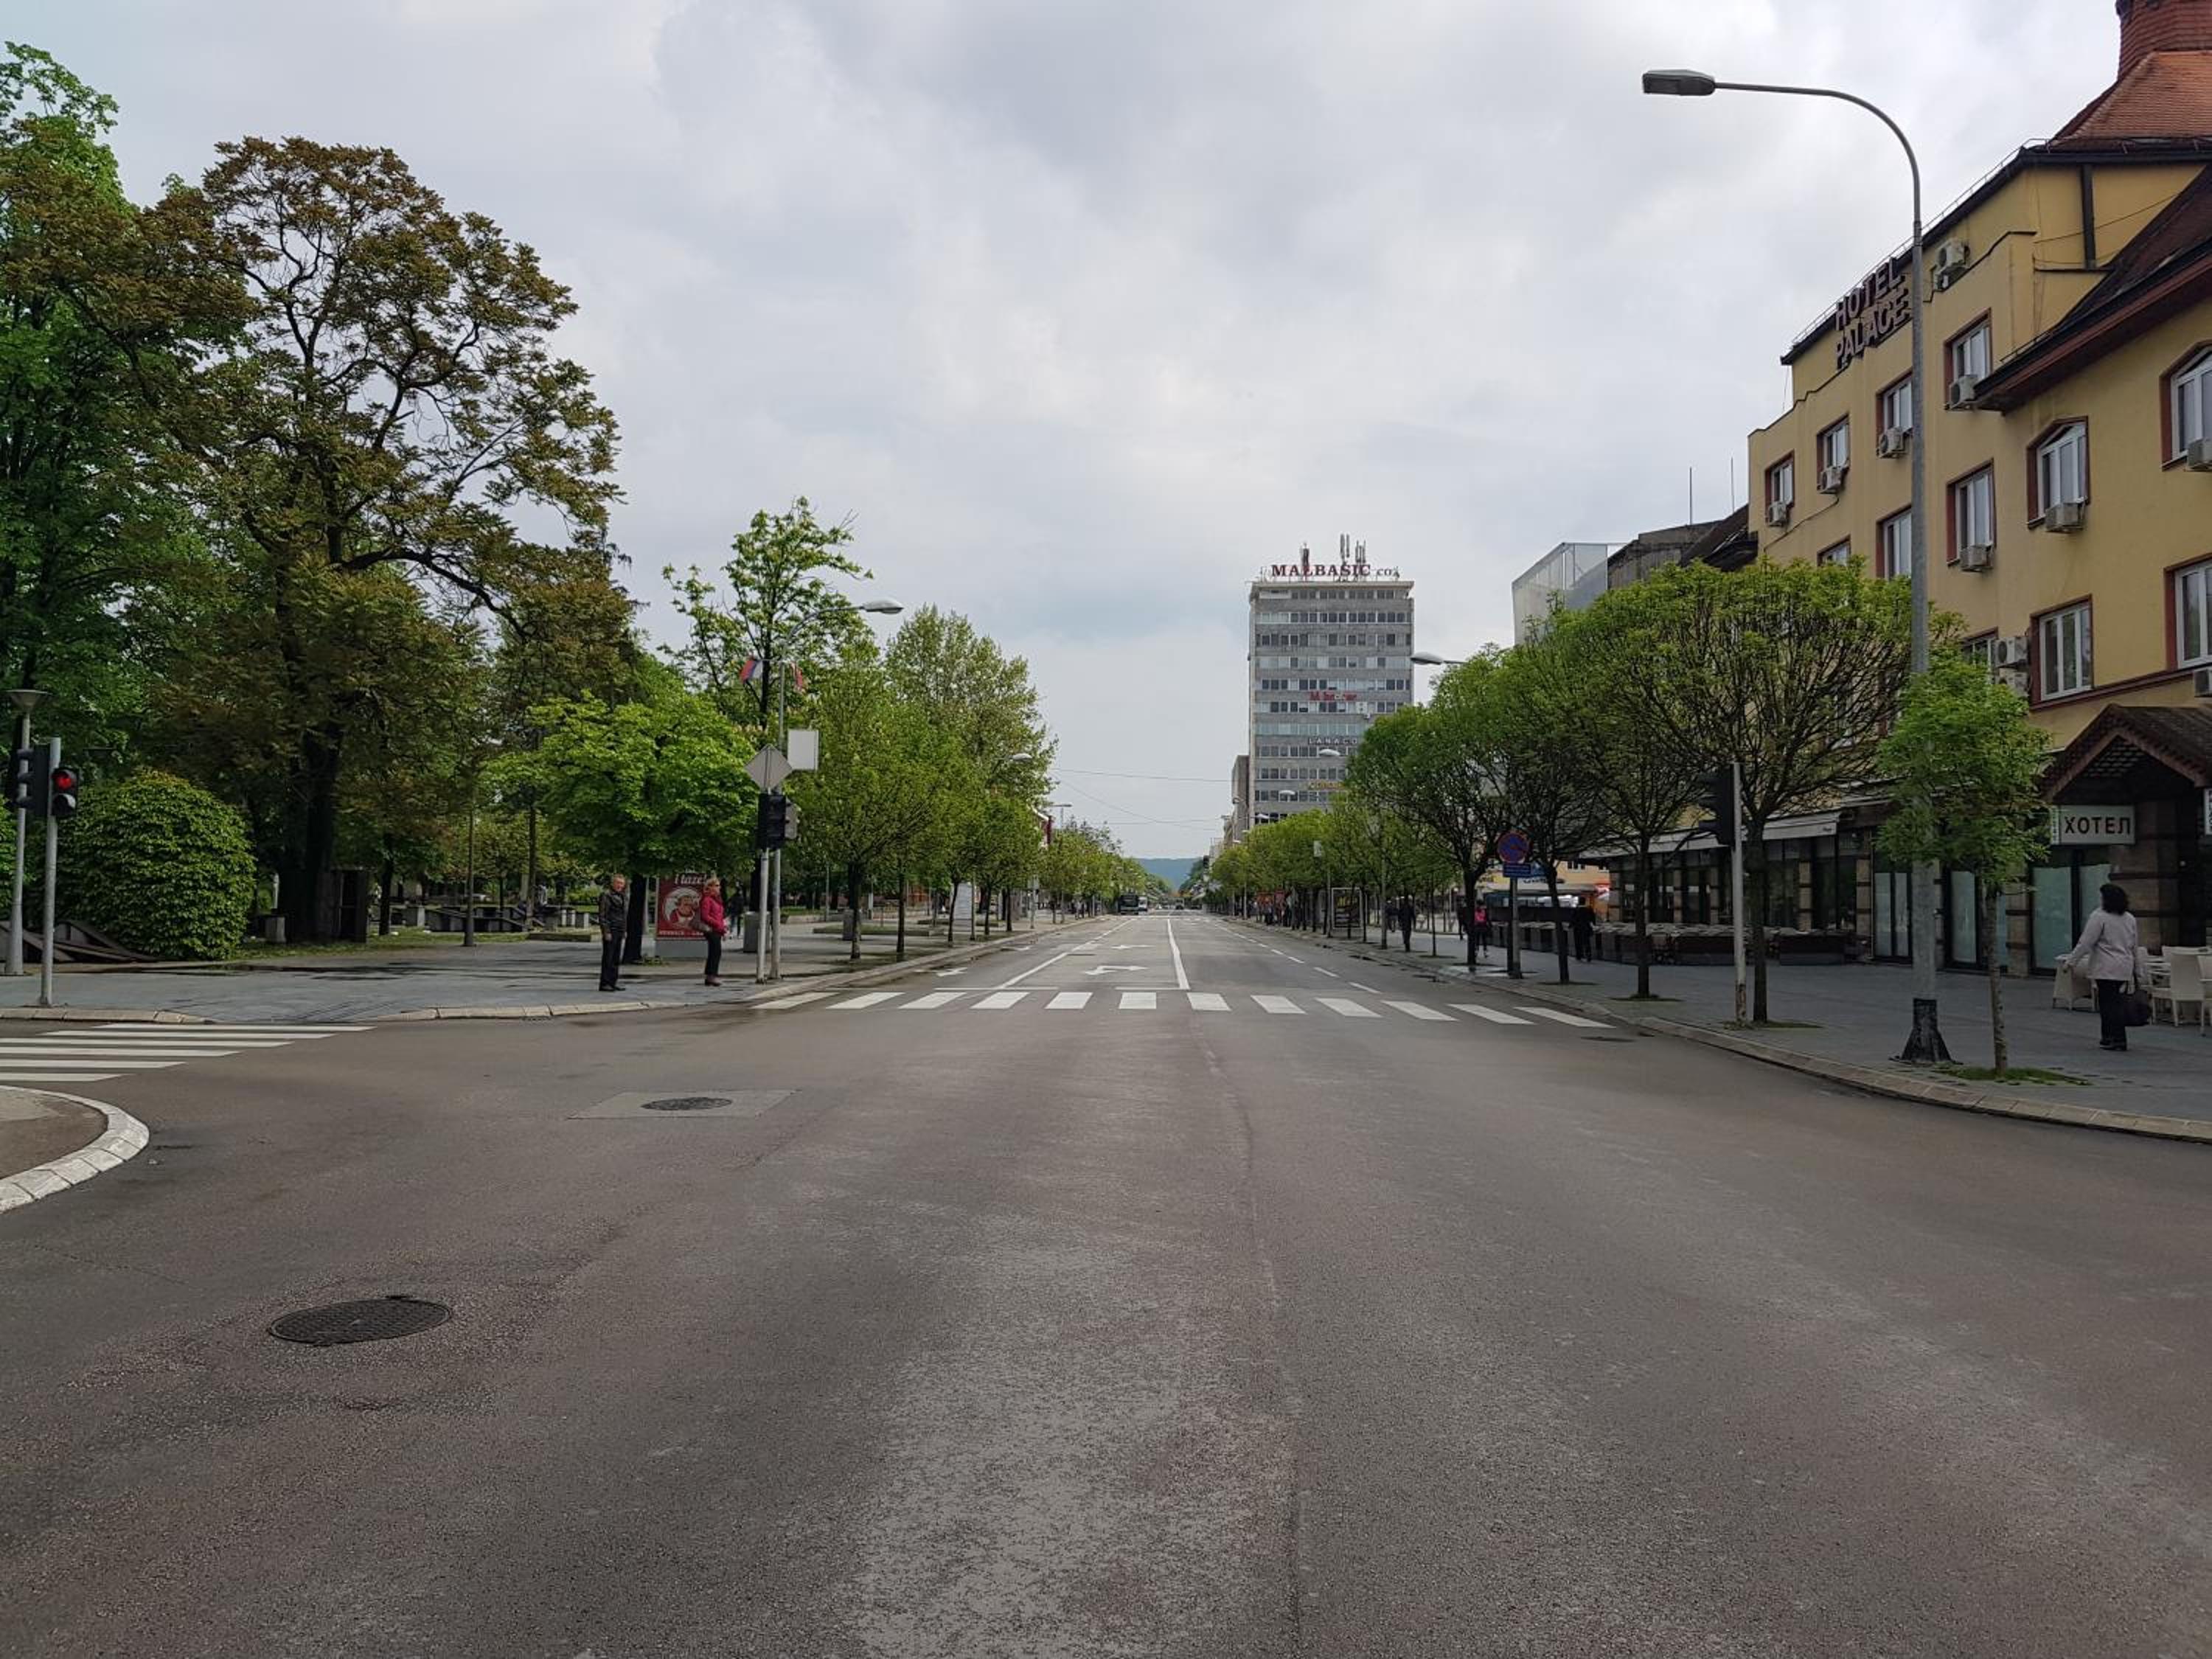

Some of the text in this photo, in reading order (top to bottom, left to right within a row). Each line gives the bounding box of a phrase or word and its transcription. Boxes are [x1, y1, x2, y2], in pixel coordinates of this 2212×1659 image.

[1835, 257, 1905, 331] HOTEL
[1836, 288, 1910, 369] PALACE
[2065, 816, 2131, 835] ХОТЕЛ
